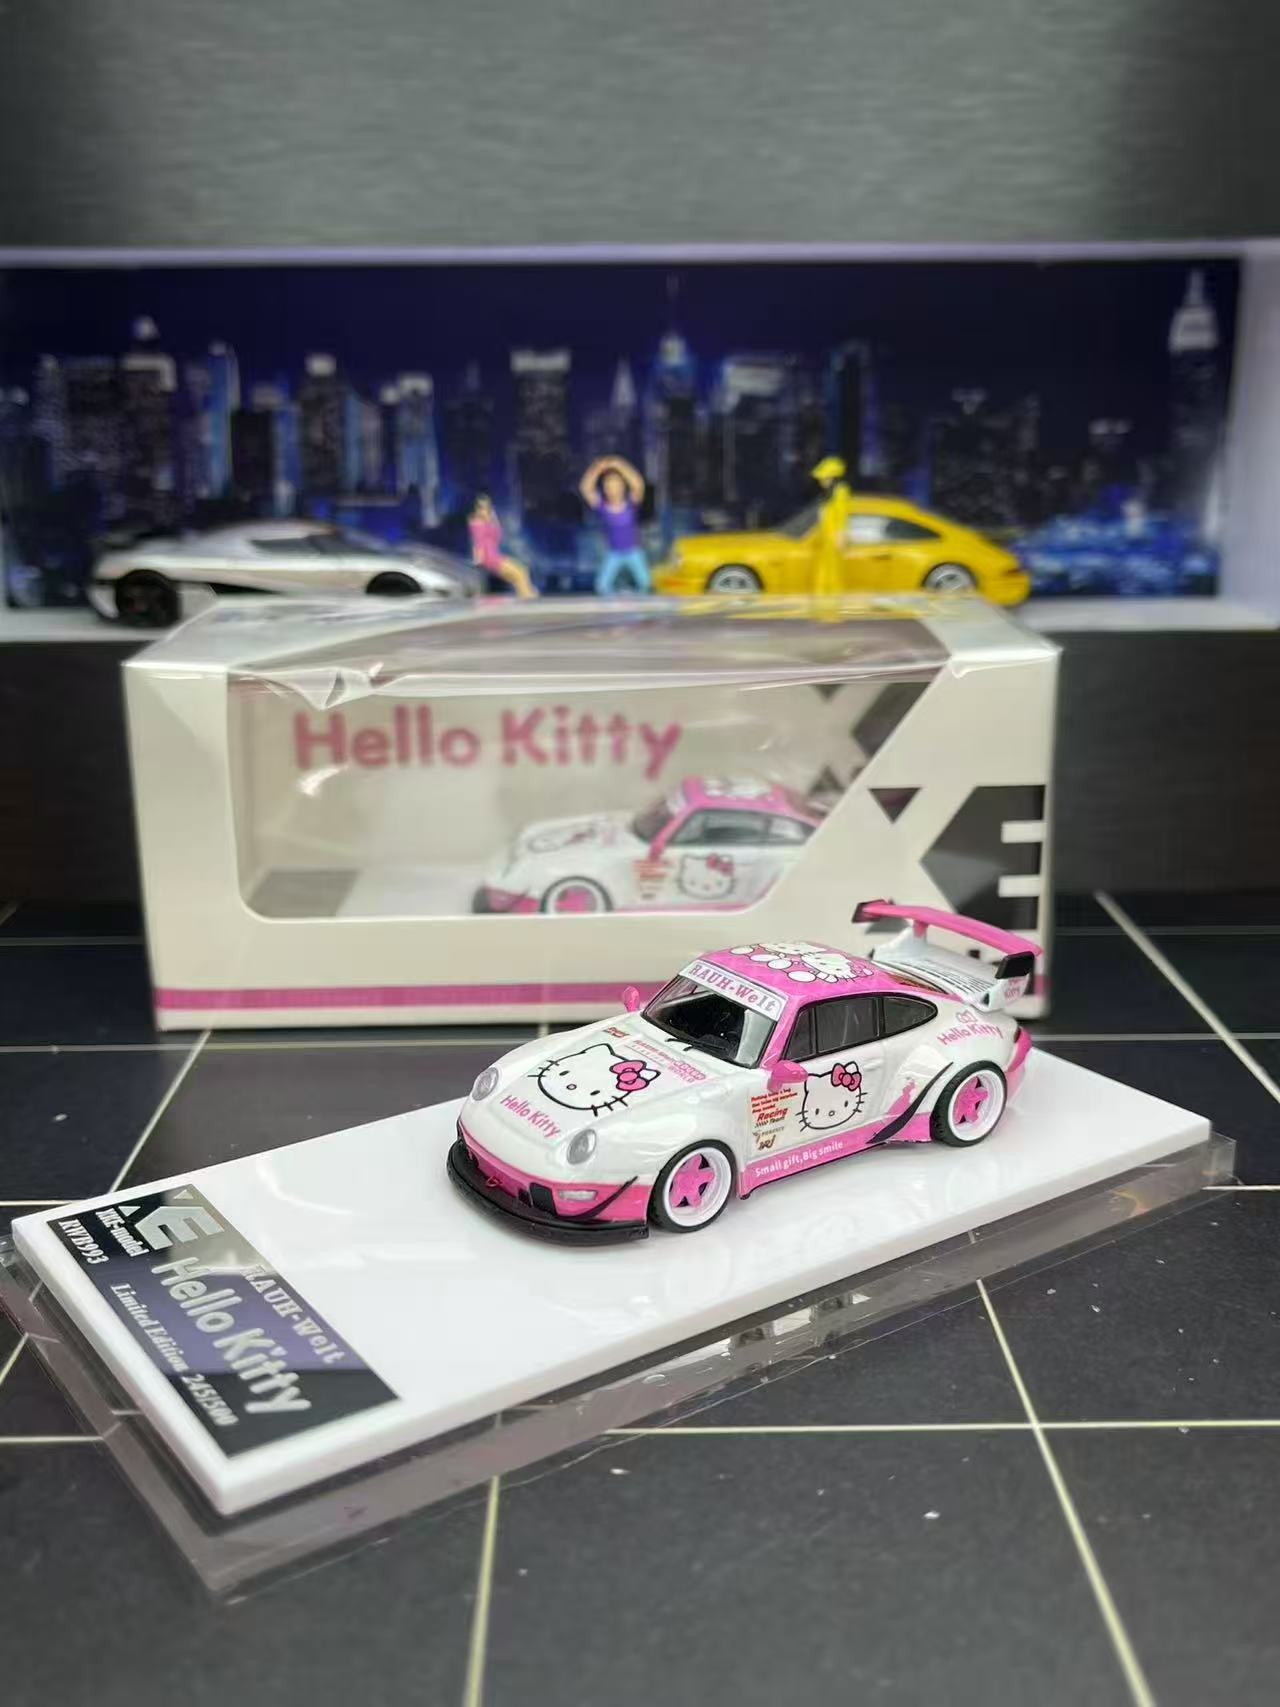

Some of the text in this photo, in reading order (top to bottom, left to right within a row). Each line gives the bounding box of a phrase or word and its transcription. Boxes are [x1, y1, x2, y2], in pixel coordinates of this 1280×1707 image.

[294, 705, 684, 780] Hello Kitty
[689, 964, 777, 1012] RAUH-Welt
[937, 1023, 1004, 1045] Hello Kitty
[500, 1094, 561, 1138] Hello Kitty
[757, 1108, 789, 1121] Racing
[755, 1161, 782, 1177] Small
[819, 1141, 844, 1156] smile
[58, 1218, 110, 1264] RWB993
[110, 1282, 159, 1327] Limited
[145, 1325, 192, 1372] Edition
[151, 1256, 313, 1415] Hello Kitty
[241, 1263, 348, 1365] RAUH-Welt
